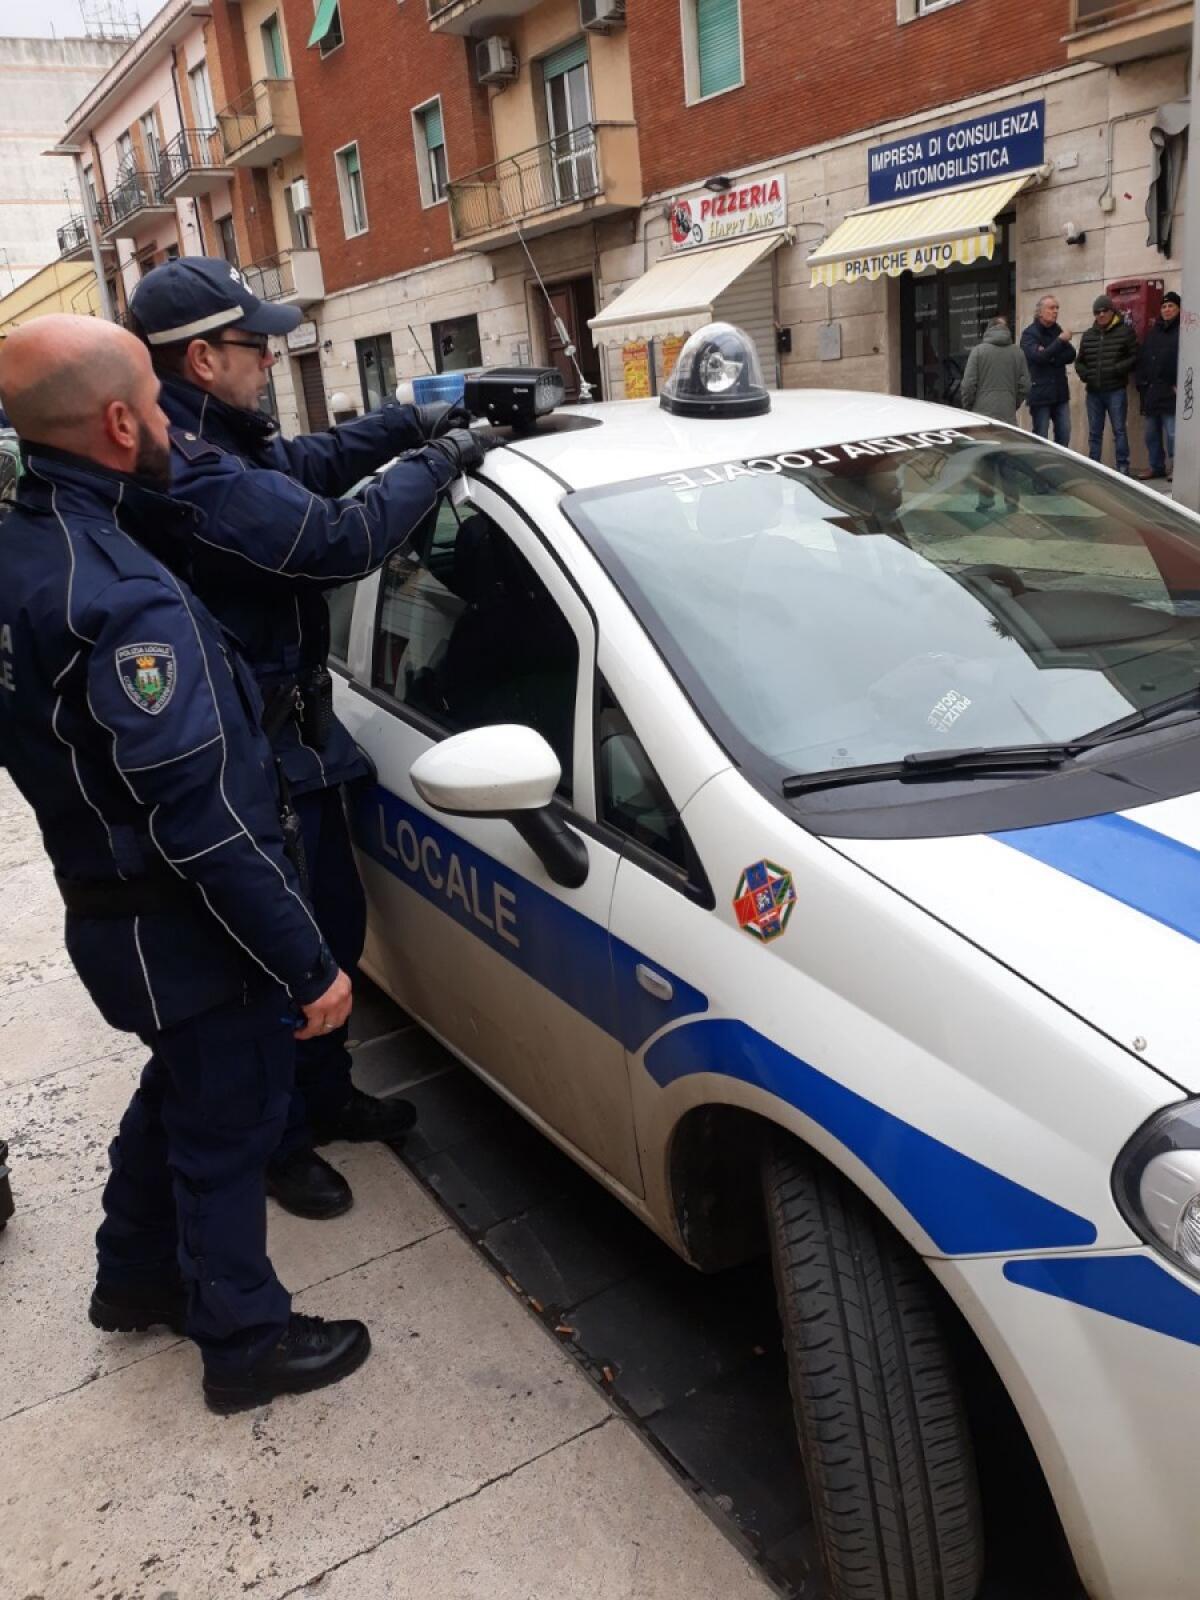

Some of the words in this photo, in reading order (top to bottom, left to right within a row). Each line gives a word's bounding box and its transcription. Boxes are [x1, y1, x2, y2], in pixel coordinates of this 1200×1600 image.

[872, 141, 923, 172] IMPRESA
[929, 137, 941, 157] DI
[946, 110, 1039, 152] CONSULENZA
[894, 147, 1009, 192] AUTOMOBILISTICA
[700, 179, 781, 222] PIZZERIA
[845, 251, 908, 276] PRATICHE
[914, 243, 953, 265] AUTO
[378, 803, 521, 949] LOCALE
